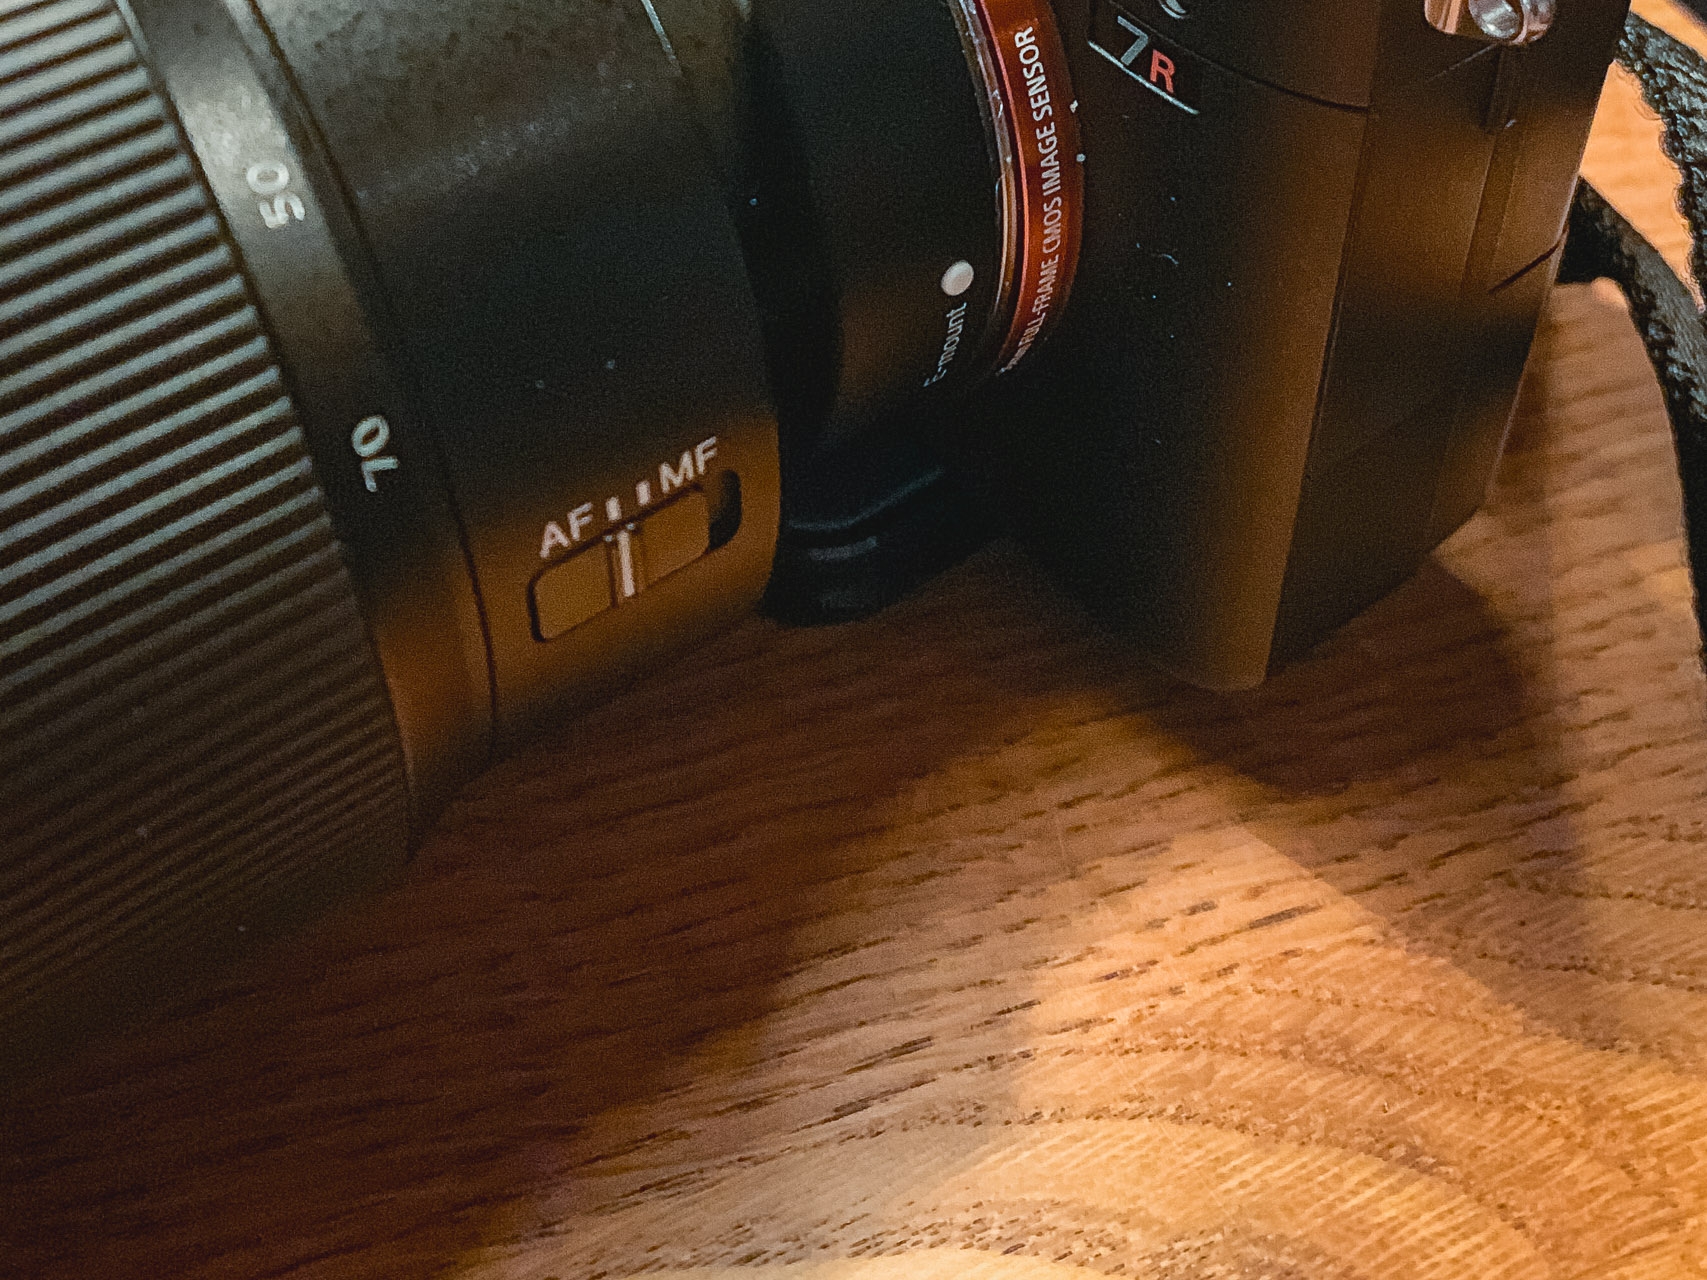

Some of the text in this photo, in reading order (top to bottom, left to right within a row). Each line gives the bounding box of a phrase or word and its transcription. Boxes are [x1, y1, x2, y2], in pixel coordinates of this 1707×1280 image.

[1014, 26, 1054, 125] SENSOR
[1117, 16, 1176, 95] 7R
[247, 161, 305, 229] 50
[1035, 121, 1063, 195] IMAGE
[1041, 195, 1063, 255] CMOS
[351, 415, 399, 493] 70
[539, 435, 718, 559] AF MF
